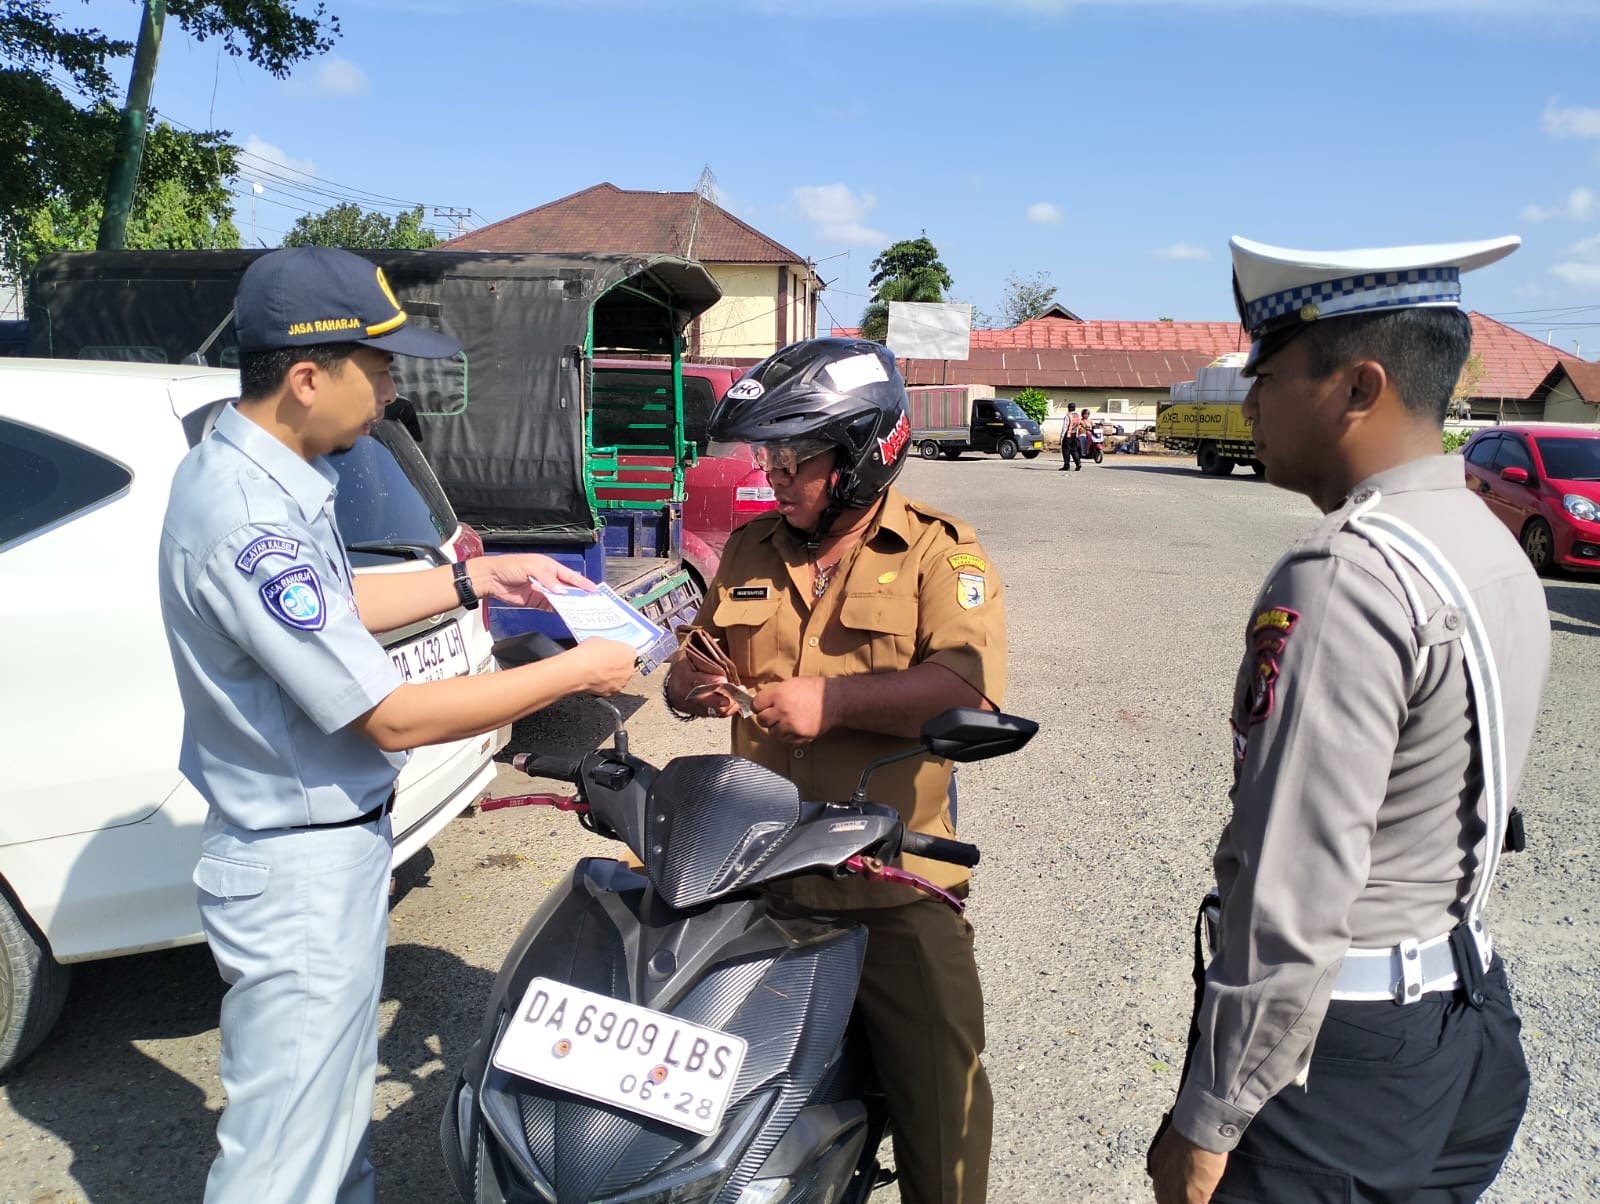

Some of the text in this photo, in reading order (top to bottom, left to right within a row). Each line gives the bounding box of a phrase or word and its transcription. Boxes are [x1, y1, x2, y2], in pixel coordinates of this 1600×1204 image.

[288, 318, 361, 336] JASA RAHARJA
[1184, 414, 1222, 424] ROBOND
[414, 636, 445, 674] 1432
[445, 627, 463, 657] LH
[524, 990, 733, 1080] DA 6909 LBS
